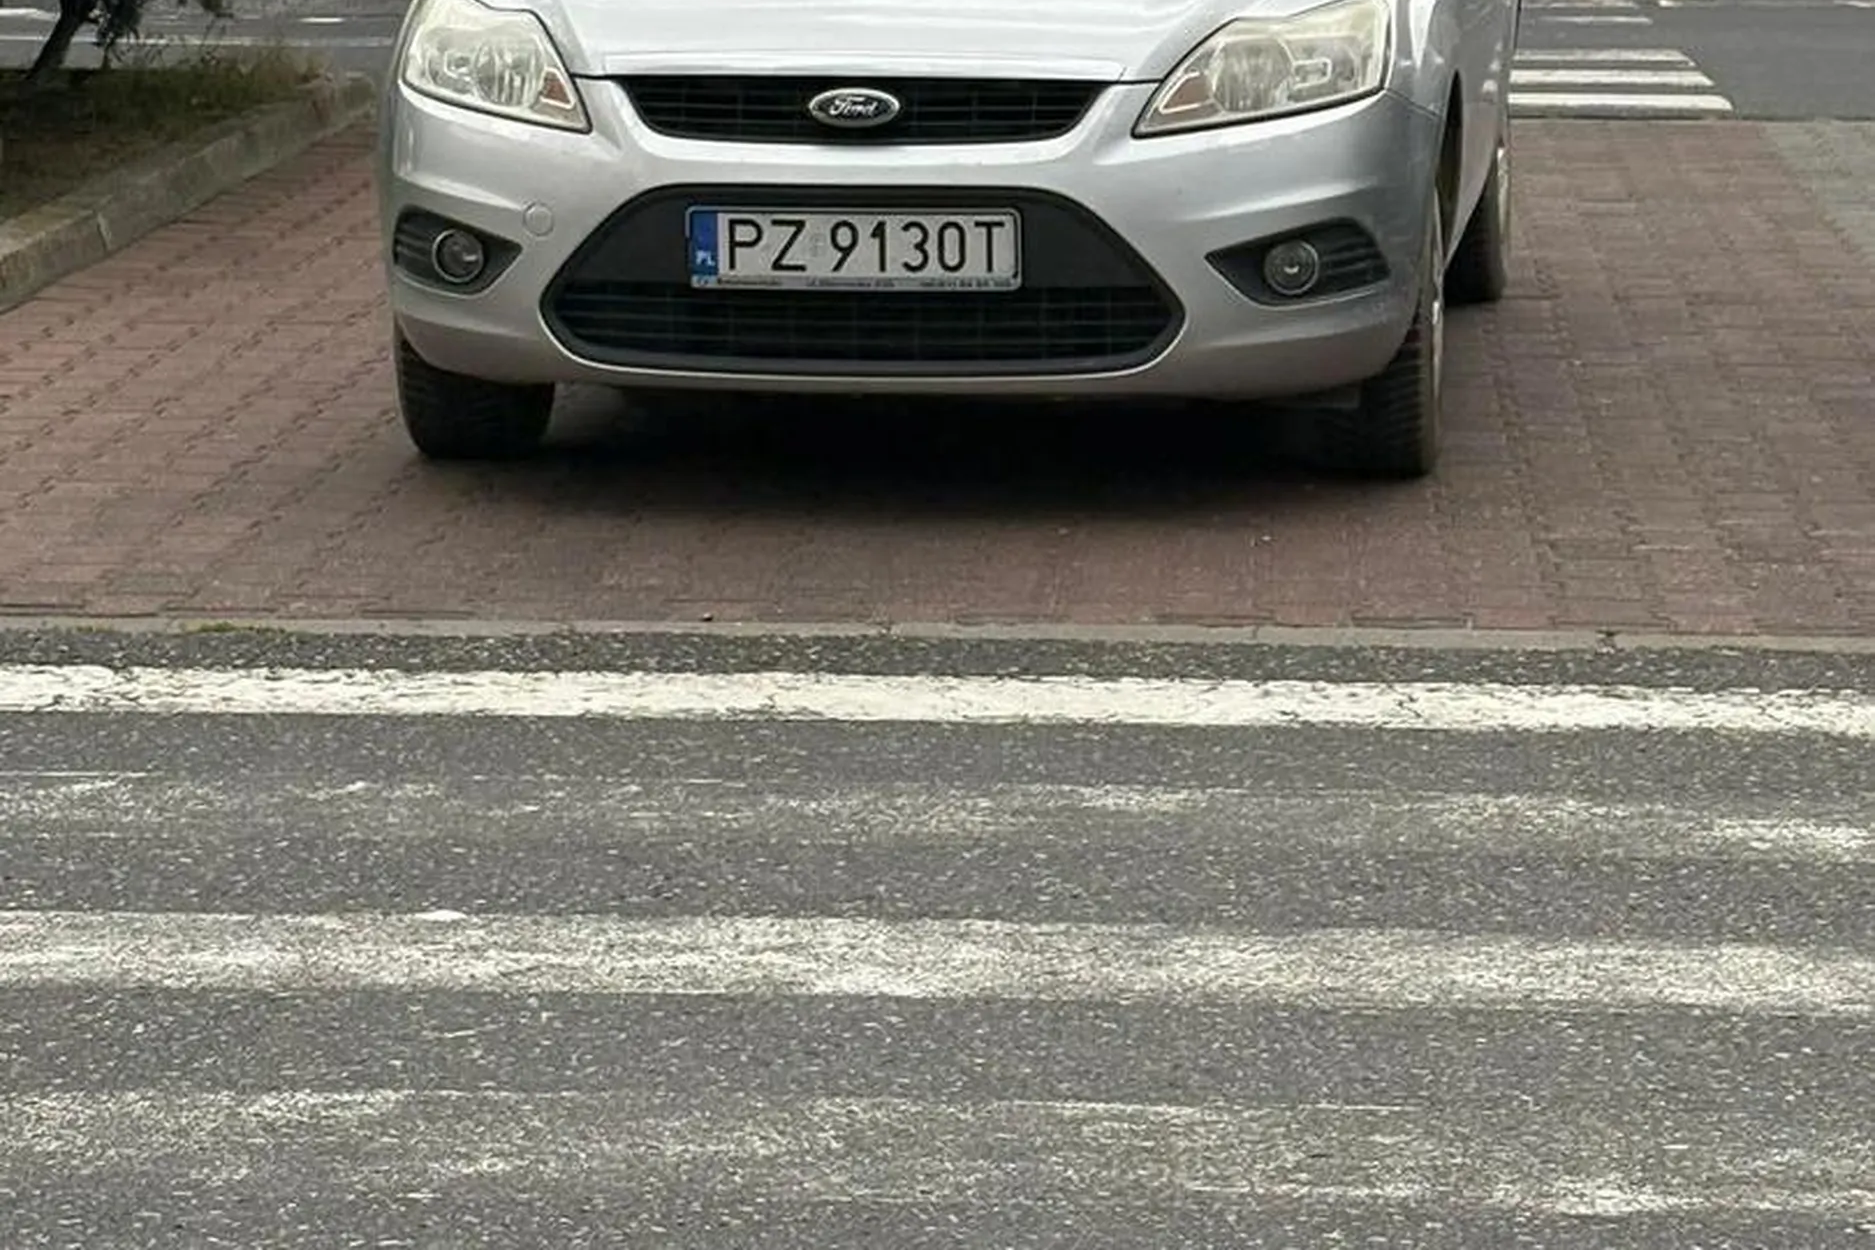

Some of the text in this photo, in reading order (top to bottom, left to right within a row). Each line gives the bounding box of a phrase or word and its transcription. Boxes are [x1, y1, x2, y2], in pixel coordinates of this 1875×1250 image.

[828, 96, 879, 116] Ford
[728, 218, 1006, 274] PZ 9130T
[695, 251, 716, 267] PL
